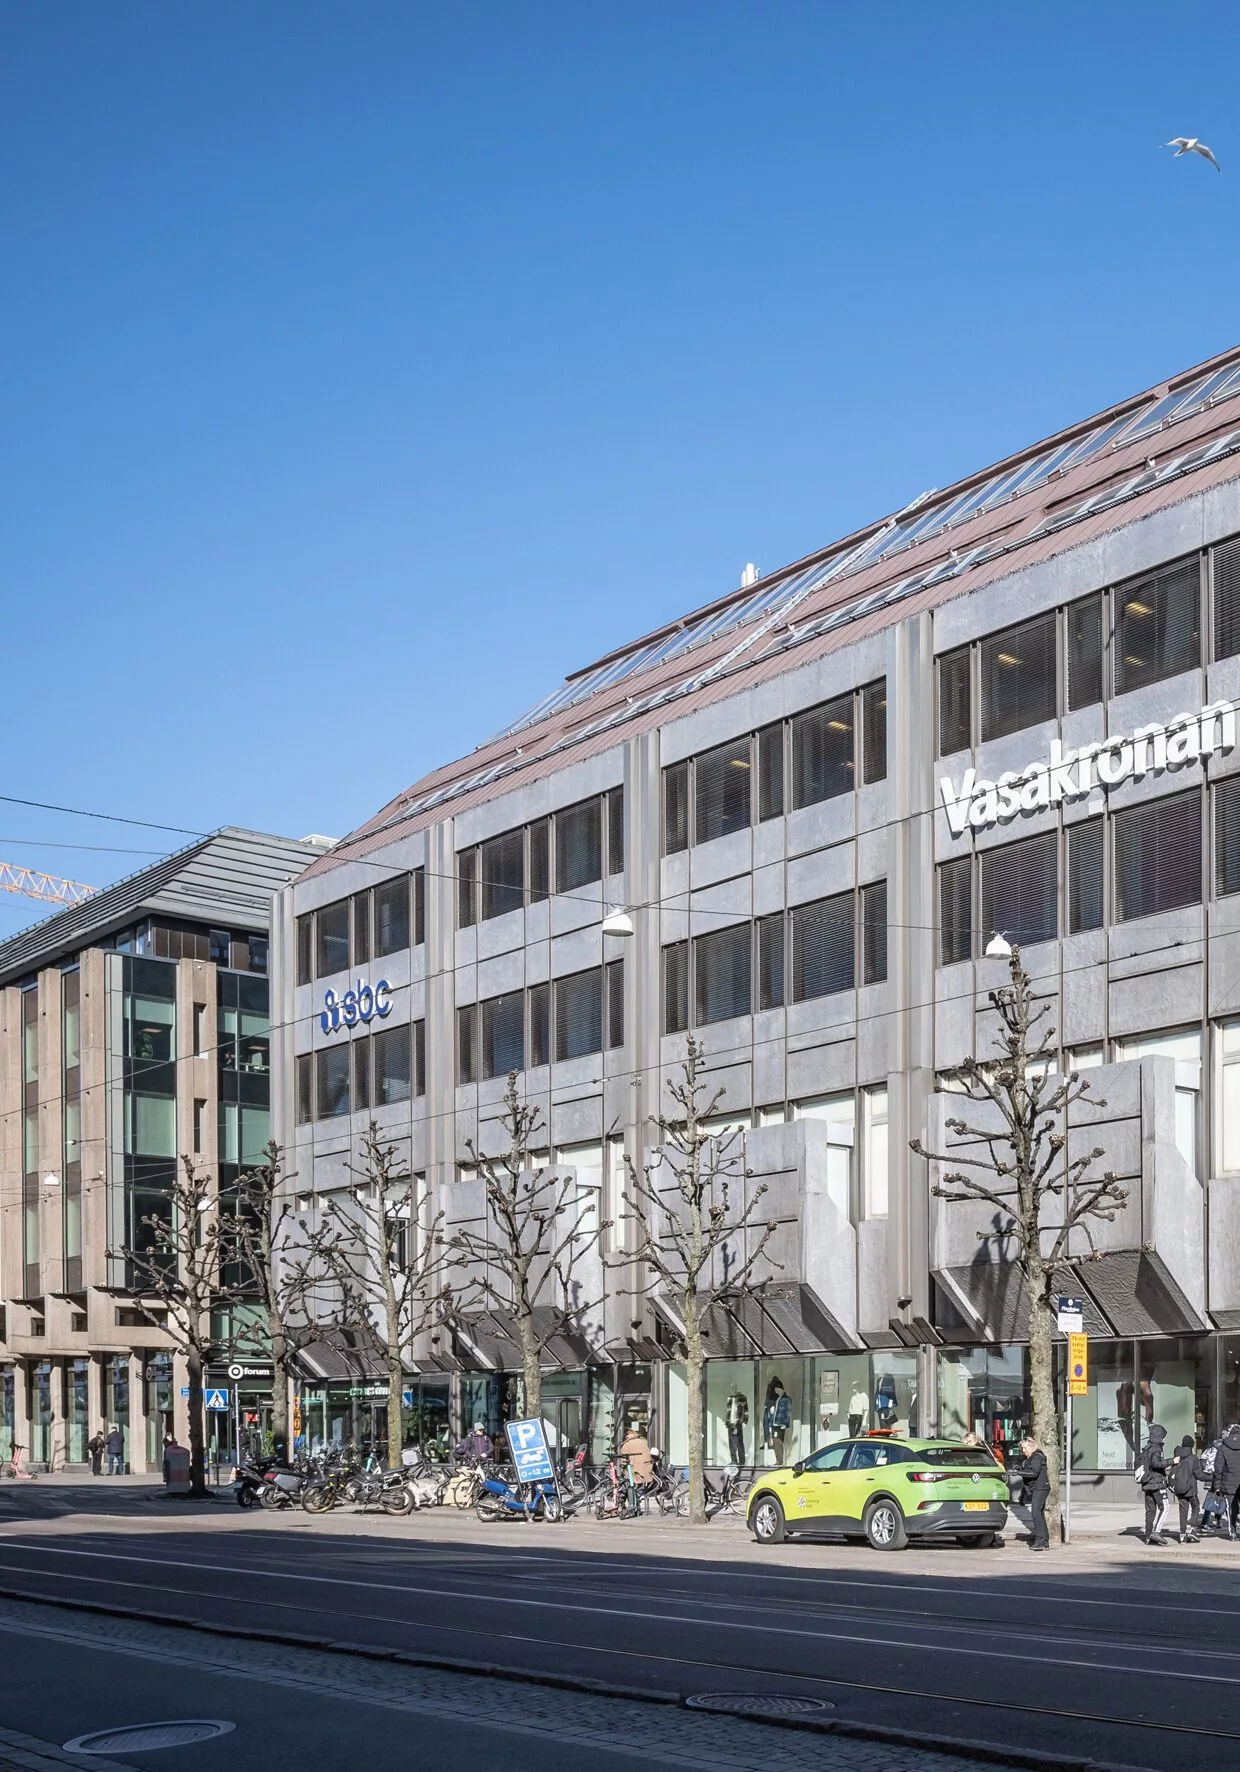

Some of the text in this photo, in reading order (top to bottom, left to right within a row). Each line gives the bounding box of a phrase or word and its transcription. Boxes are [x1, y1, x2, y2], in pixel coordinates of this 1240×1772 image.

[940, 699, 1236, 836] Vasakronan
[343, 979, 394, 1025] sbc
[243, 1367, 269, 1375] forum
[516, 1423, 536, 1449] P
[521, 1469, 542, 1478] 0-12
